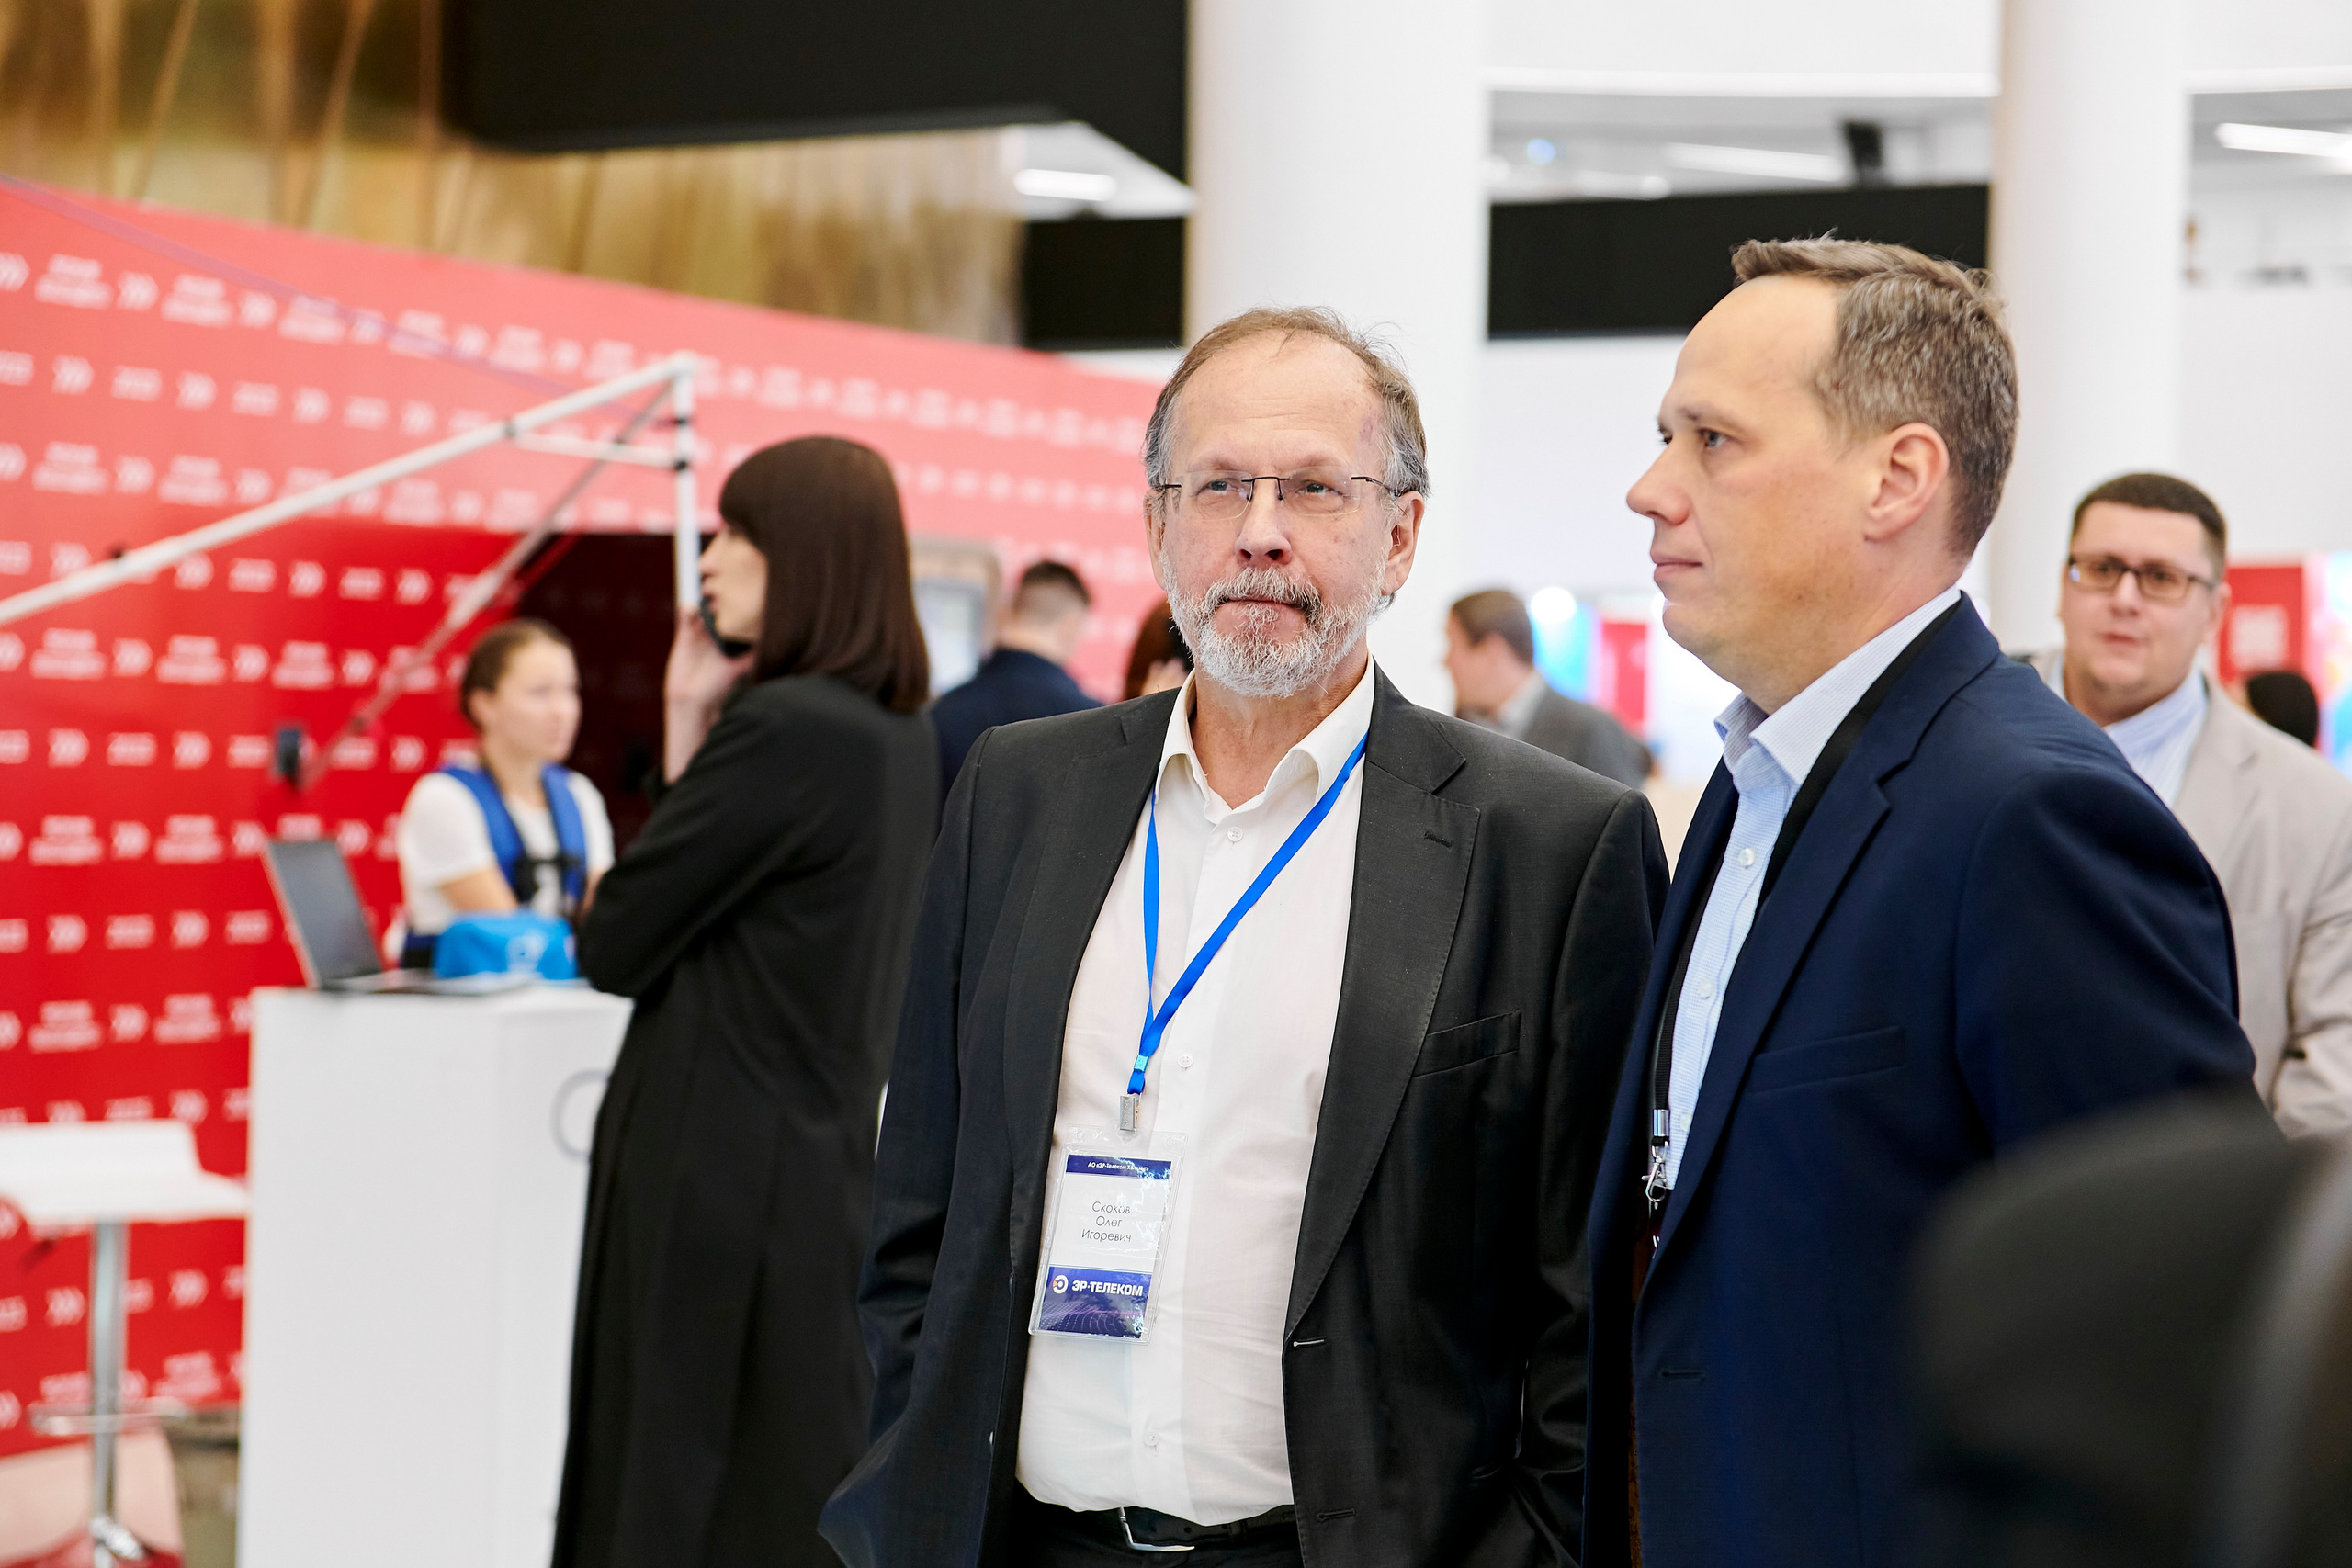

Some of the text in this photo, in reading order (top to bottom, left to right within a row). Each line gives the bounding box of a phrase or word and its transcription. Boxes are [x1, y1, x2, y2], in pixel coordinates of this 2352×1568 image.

[1092, 1201, 1131, 1214] Скоков
[1096, 1215, 1123, 1227] Олег
[1081, 1228, 1132, 1243] Игоревич
